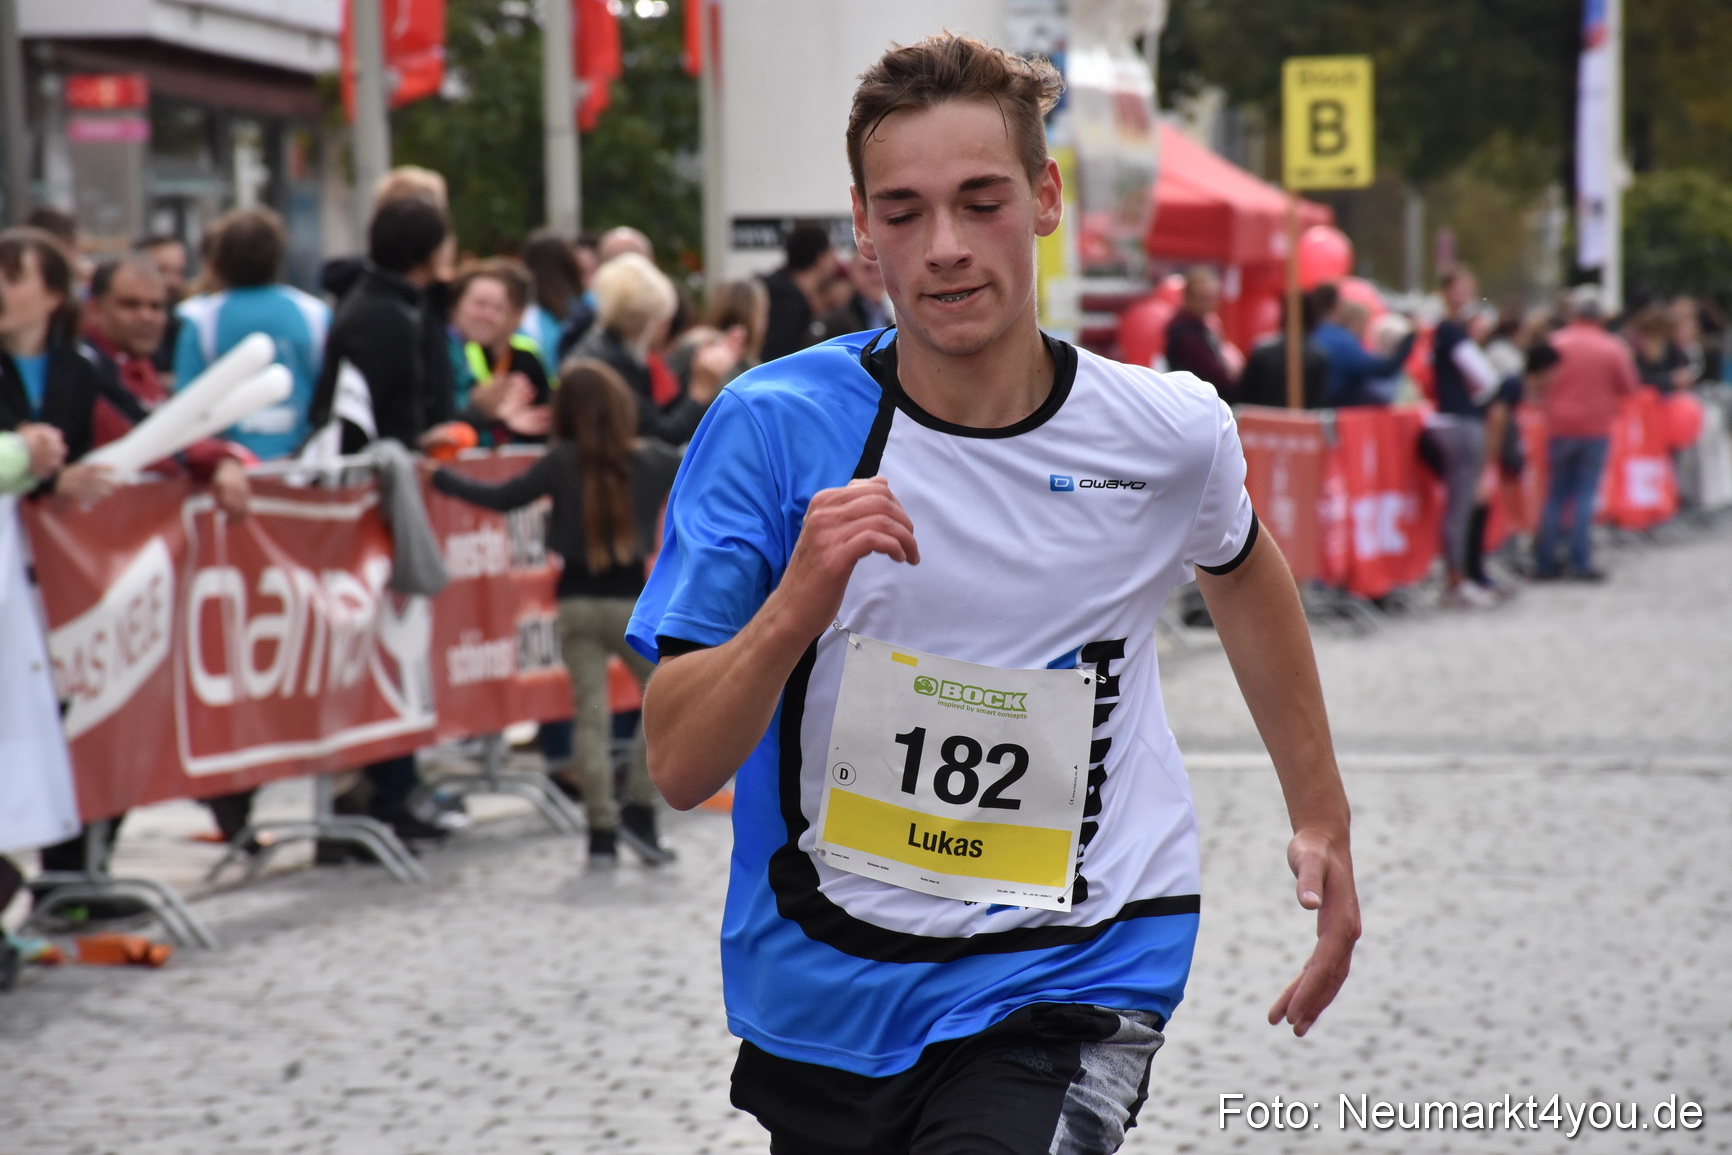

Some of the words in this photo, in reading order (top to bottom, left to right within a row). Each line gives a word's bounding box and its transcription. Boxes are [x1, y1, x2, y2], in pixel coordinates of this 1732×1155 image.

[1308, 98, 1348, 158] B
[937, 699, 964, 711] inspired
[966, 704, 975, 713] by
[976, 708, 996, 716] smart
[997, 710, 1027, 720] concepts
[939, 680, 1028, 712] BOCK
[840, 767, 849, 780] D
[894, 726, 1030, 811] 182
[907, 822, 984, 859] Lukas
